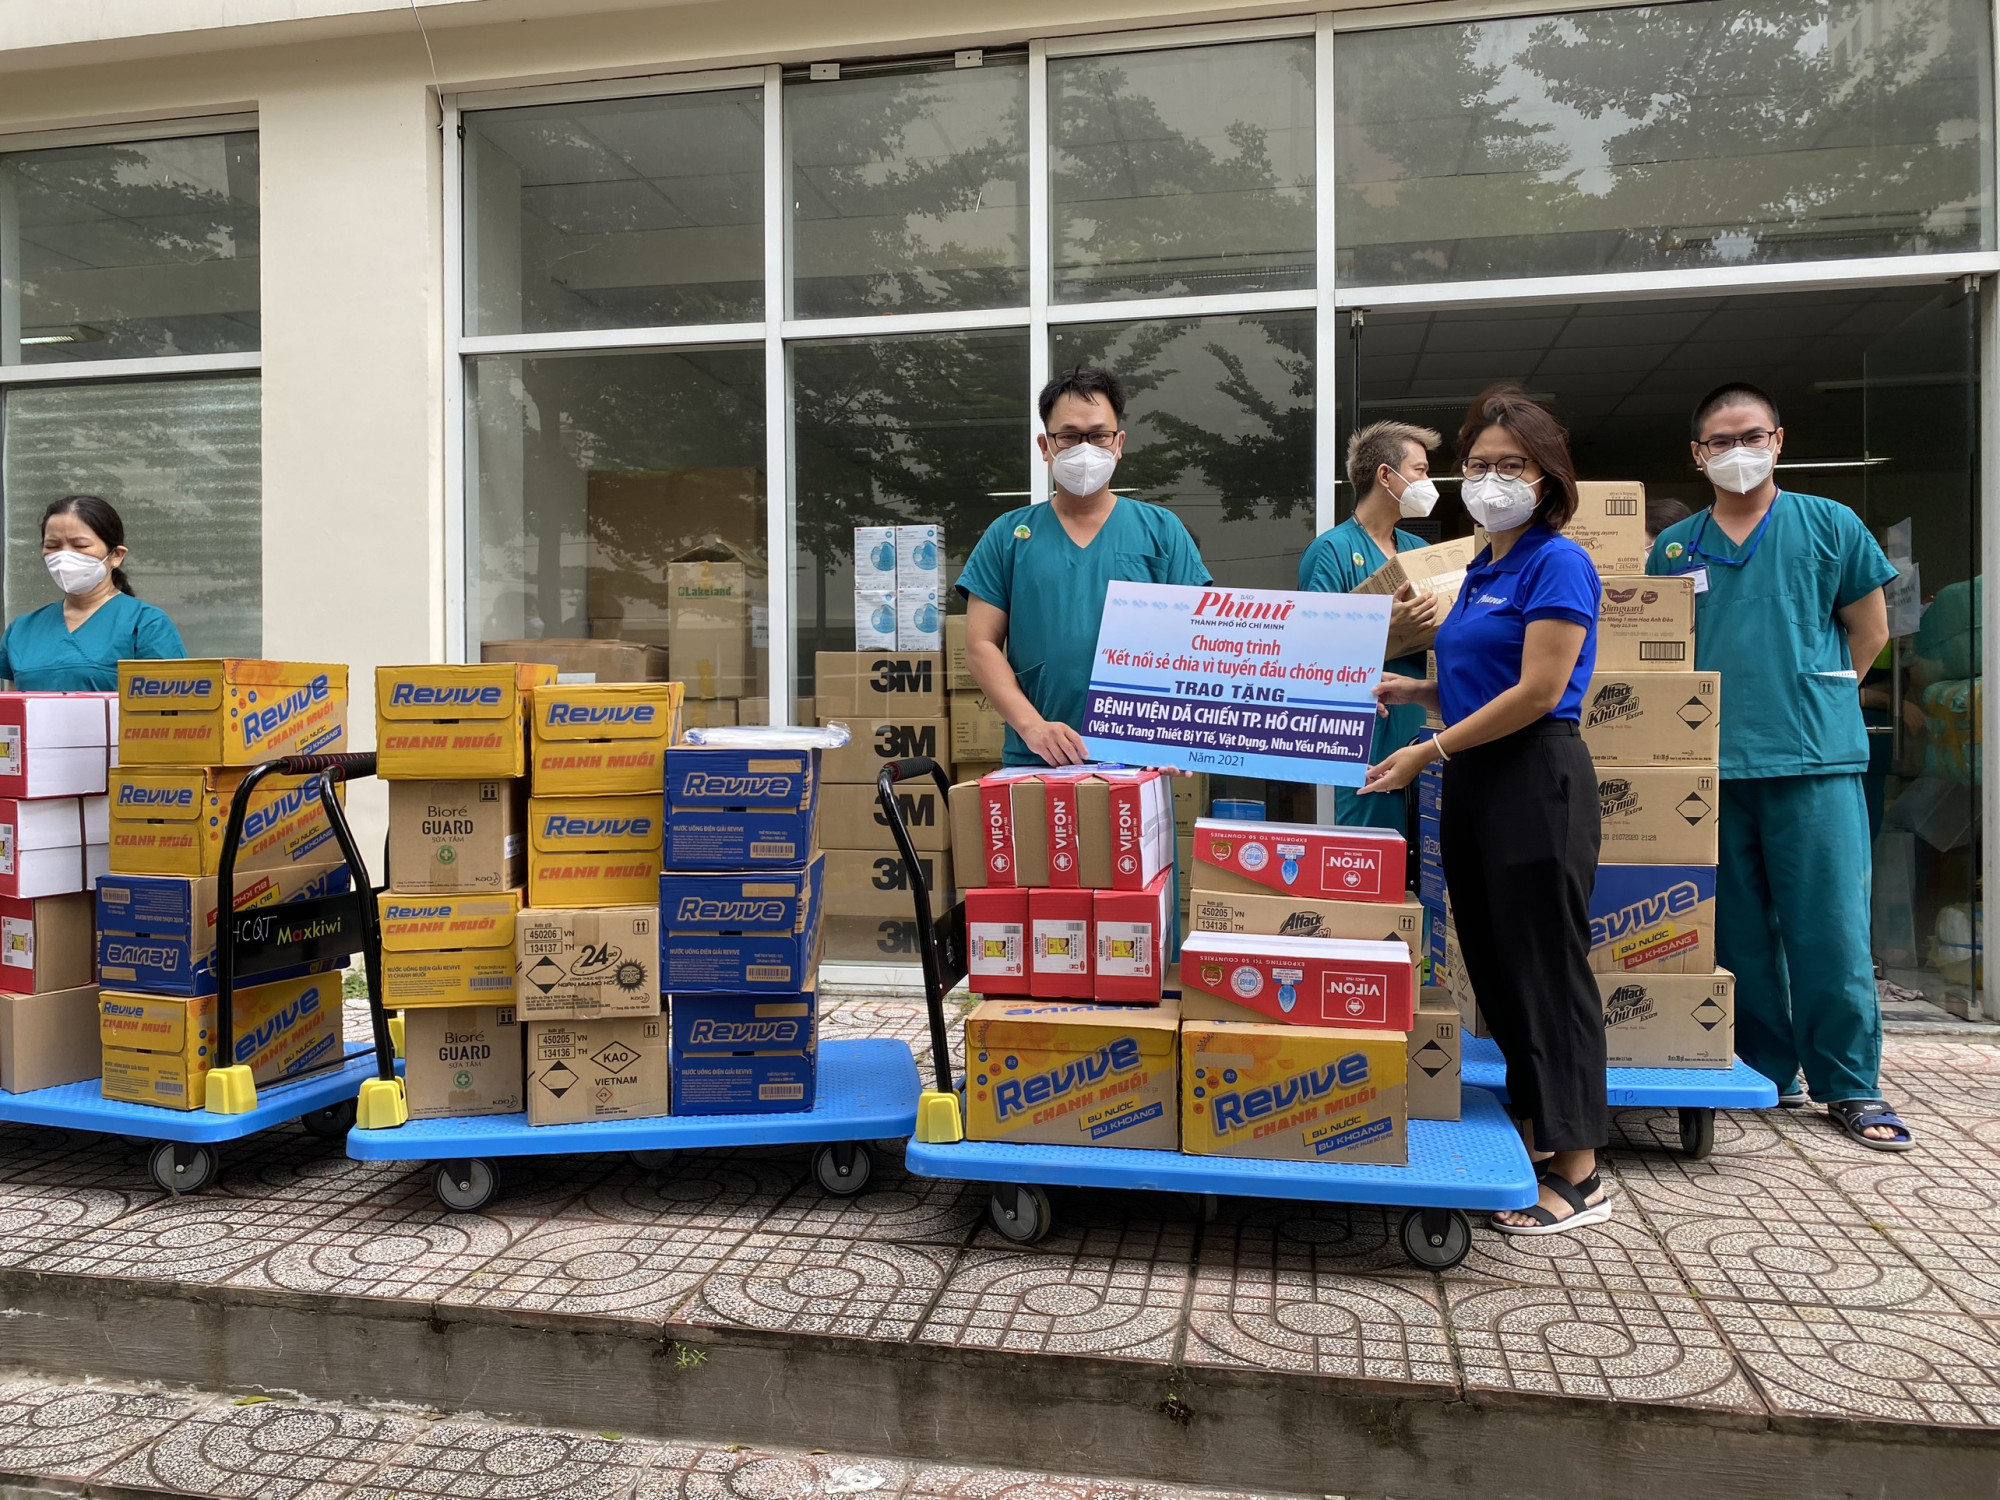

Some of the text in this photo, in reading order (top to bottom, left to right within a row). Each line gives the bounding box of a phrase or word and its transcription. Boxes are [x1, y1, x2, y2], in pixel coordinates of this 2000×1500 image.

[685, 586, 731, 596] Lakeland
[1600, 602, 1644, 616] Slimguard
[1190, 618, 1216, 627] THÀNH
[1218, 619, 1234, 628] PHỐ
[1236, 620, 1248, 628] HỒ
[1249, 620, 1262, 629] CHÍ
[1192, 634, 1280, 656] Chương trình
[870, 660, 932, 692] 3M
[1132, 651, 1153, 668] nối
[1156, 652, 1169, 669] sẻ
[1172, 656, 1199, 672] chia
[1202, 659, 1215, 673] vì
[1218, 658, 1256, 679] tuyến
[1260, 660, 1286, 678] đầu
[1290, 662, 1333, 684] chống
[128, 676, 212, 698] Revive
[390, 682, 502, 706] Revive
[1175, 680, 1285, 703] TRAO TẶNG
[1599, 684, 1633, 701] Attack
[242, 673, 331, 749] Revive
[545, 702, 656, 726] Revive
[1094, 698, 1364, 736] BỆNH VIỆN DÃ CHIẾN TP. HỒ CHÍ MINH
[1587, 697, 1639, 728] Khử mùi
[1626, 710, 1643, 721] Extra
[124, 727, 212, 740] CHANH MUỐI
[267, 702, 335, 750] CHANH MUỐI
[1089, 719, 1109, 733] (Vật
[1110, 722, 1126, 736] Tư,
[1127, 724, 1154, 740] Trang
[1156, 726, 1182, 741] Thiết
[1183, 730, 1194, 742] Bị
[1194, 731, 1202, 742] Y
[1201, 732, 1216, 746] Tế,
[1219, 732, 1235, 746] Vật
[1238, 734, 1268, 751] Dụng,
[1271, 738, 1294, 751] Nhu
[1295, 738, 1314, 753] Yếu
[386, 735, 502, 749] CHANH MUỐI
[874, 726, 936, 758] 3M
[541, 754, 655, 769] CHANH MUỐI
[1189, 751, 1244, 767] Năm 2021
[117, 784, 193, 806] Revive
[683, 772, 791, 797] Revive
[1599, 781, 1632, 797] Attack
[428, 805, 467, 817] Bioré
[873, 794, 934, 826] 3M
[1624, 806, 1642, 816] Extra
[422, 820, 473, 835] GUARD
[543, 815, 652, 839] Revive
[990, 803, 1003, 851] VIFON
[1054, 801, 1066, 849] VIFON
[1119, 803, 1131, 851] VIFON
[114, 834, 193, 847] CHANH MUỐI
[538, 864, 652, 881] CHANH MUỐI
[1330, 856, 1375, 870] VIFON
[872, 858, 933, 891] 3M
[385, 905, 452, 920] Revive
[676, 897, 785, 921] Revive
[1201, 909, 1228, 918] 450205
[1286, 911, 1324, 928] Attack
[277, 917, 341, 946] Maxkiwi
[385, 919, 496, 935] CHANH MUỐI
[530, 930, 557, 939] 450206
[1201, 921, 1227, 931] 134136
[530, 944, 556, 953] 134137
[1621, 928, 1669, 953] BÙ NƯỚC
[1627, 935, 1691, 965] BÙ KHOÁNG
[107, 944, 178, 971] Revive
[580, 942, 608, 967] 24
[1330, 982, 1380, 996] VIFON
[1611, 986, 1647, 1003] Attack
[103, 1002, 144, 1017] Revive
[1631, 998, 1653, 1016] mùi
[1640, 1011, 1658, 1022] Extra
[141, 1020, 171, 1034] MUỐI
[445, 1031, 485, 1044] Bioré
[691, 1019, 798, 1043] Revive
[543, 1035, 570, 1044] 450205
[439, 1045, 491, 1061] GUARD
[543, 1048, 570, 1058] 134136
[603, 1052, 628, 1063] KAO
[595, 1076, 638, 1086] VIETNAM
[995, 1035, 1140, 1122] Revive
[1033, 1072, 1148, 1126] CHANH MUỐI
[1213, 1051, 1370, 1136] Revive
[1088, 1101, 1134, 1124] BÙ NƯỚC
[1093, 1108, 1155, 1136] BÙ KHOÁNG
[1253, 1087, 1377, 1140] CHANH MUỐI
[1312, 1114, 1362, 1139] BÙ NƯỚC
[1318, 1123, 1384, 1152] BÙ KHOÁNG
